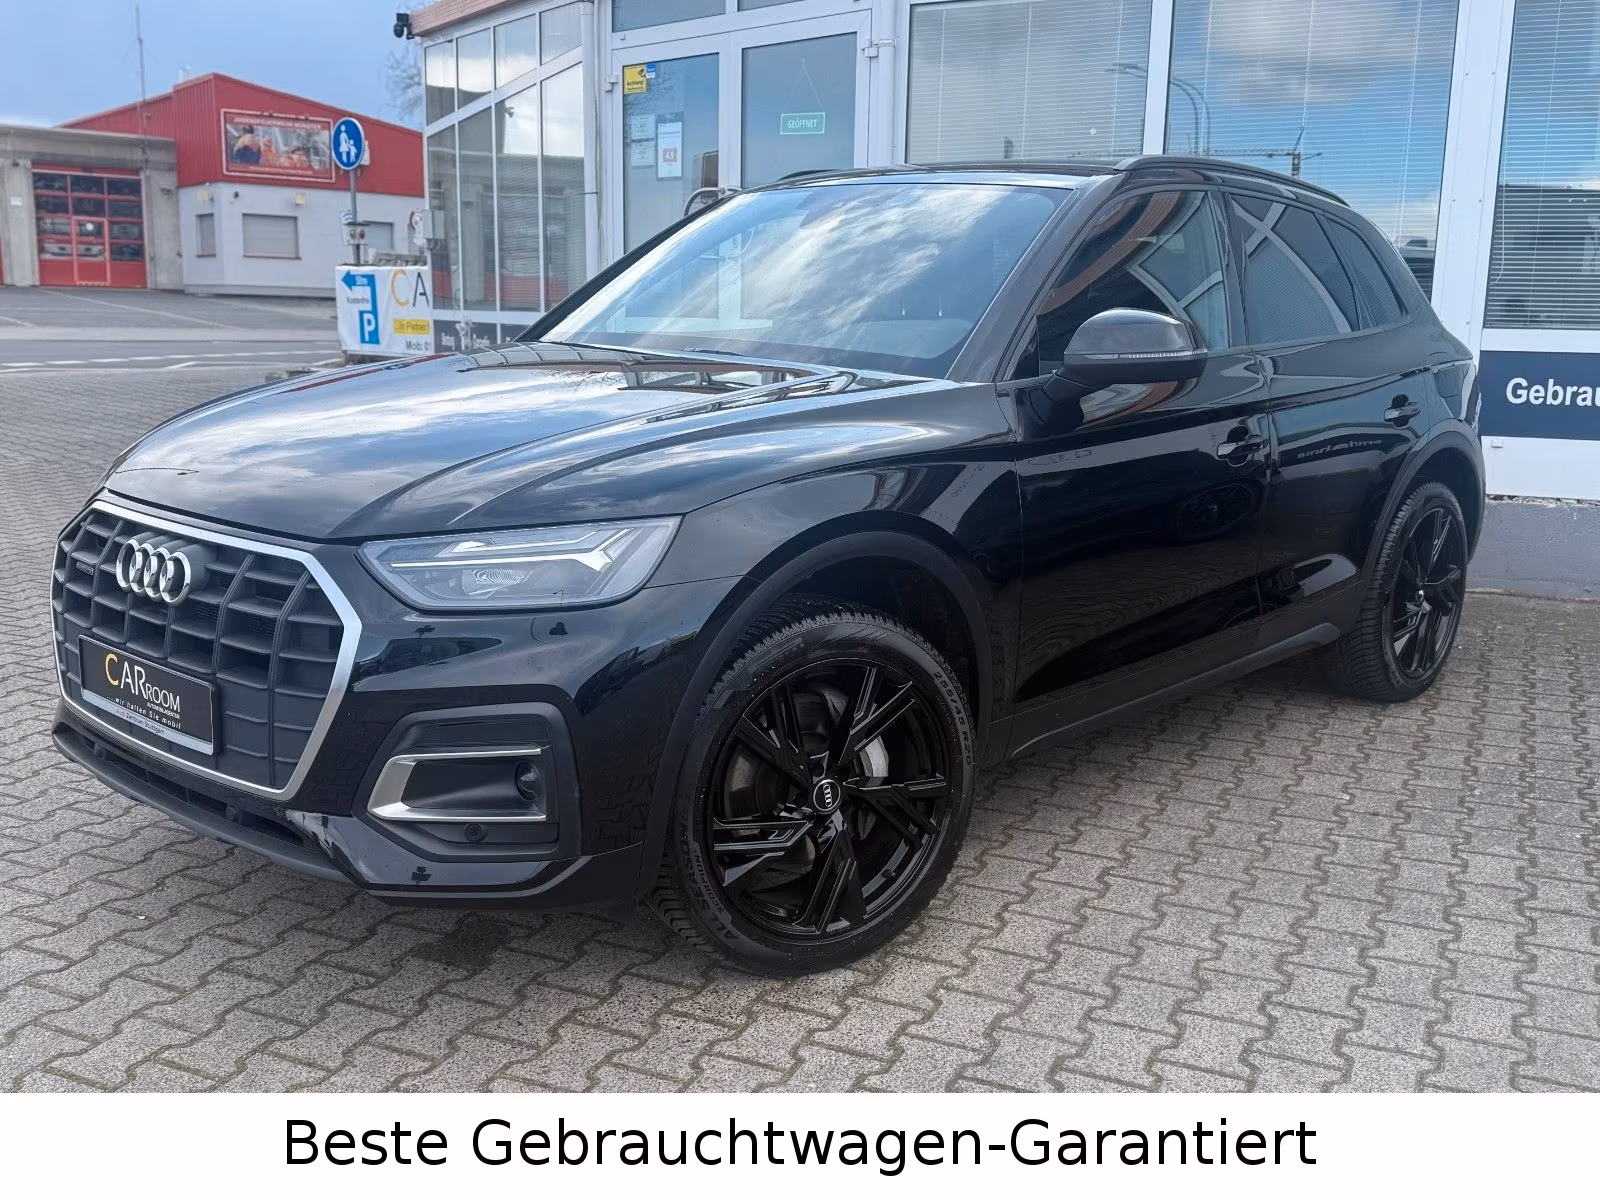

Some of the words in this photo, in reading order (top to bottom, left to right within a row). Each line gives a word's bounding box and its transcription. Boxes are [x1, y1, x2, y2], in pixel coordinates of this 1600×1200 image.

[787, 118, 818, 129] GEÖFFNET
[363, 313, 375, 341] P
[126, 702, 147, 715] halten
[149, 710, 160, 721] Sie
[161, 717, 181, 730] mobil
